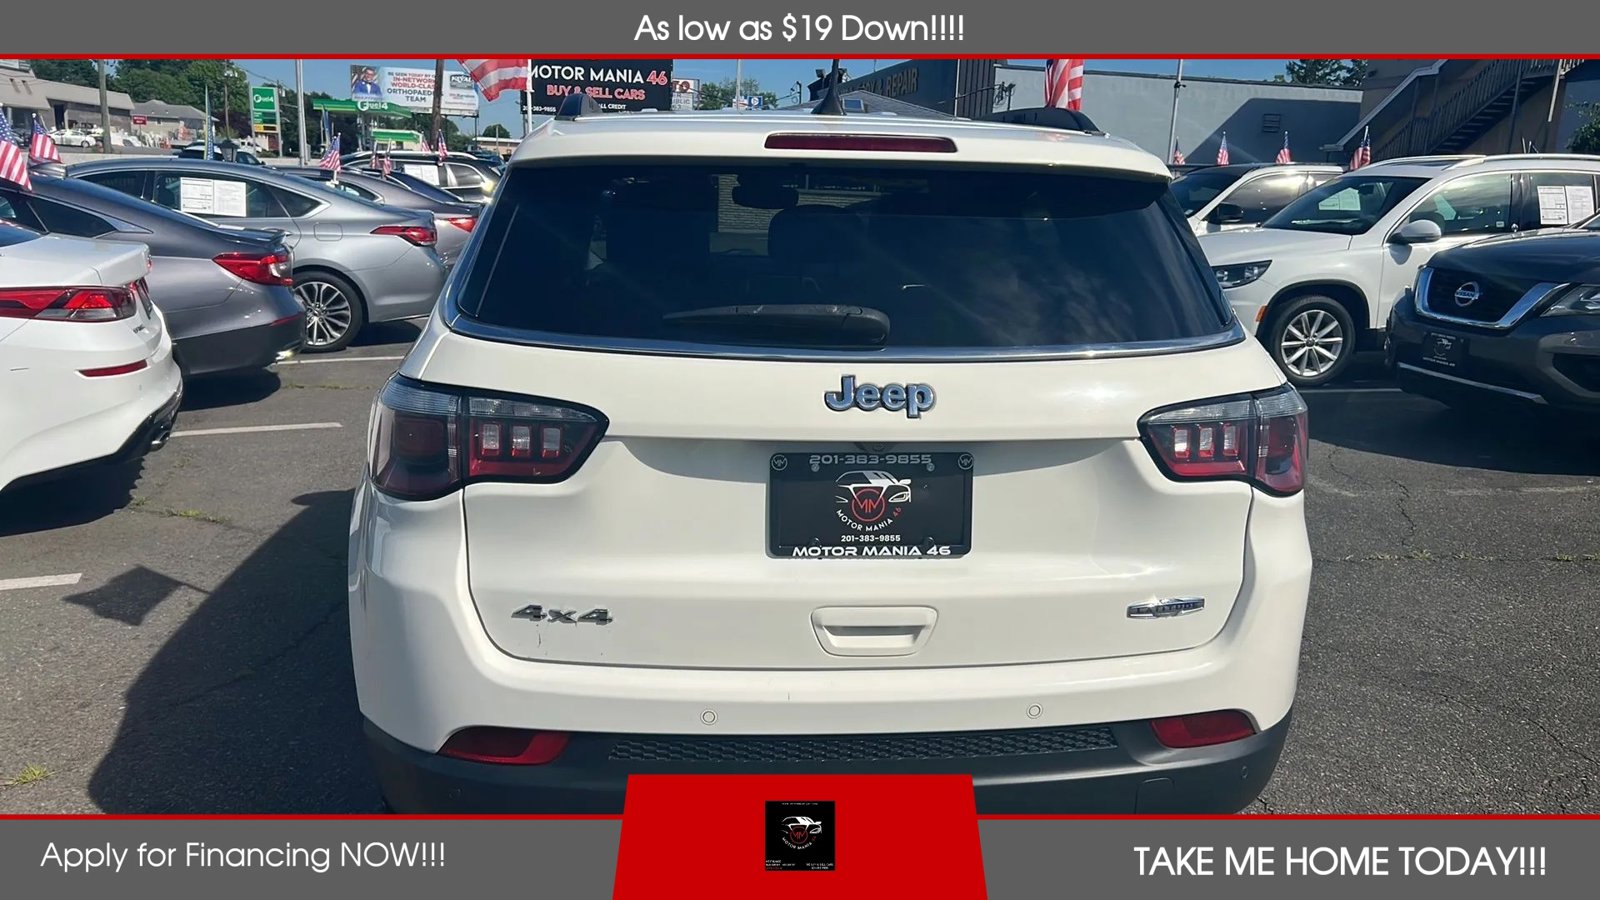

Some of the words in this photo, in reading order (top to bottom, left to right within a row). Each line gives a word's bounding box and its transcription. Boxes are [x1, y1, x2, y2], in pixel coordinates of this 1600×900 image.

[589, 68, 645, 84] MANIA
[645, 70, 669, 86] 46
[885, 67, 919, 98] REPAIR
[391, 82, 436, 90] WORLD-CLAS
[386, 88, 433, 97] ORTHOPAED
[546, 84, 571, 97] BUY
[584, 86, 614, 99] SELL
[614, 88, 646, 101] CARS
[405, 95, 427, 103] TEAM
[823, 374, 937, 420] Jeep
[809, 454, 933, 466] 201-383-9855
[836, 509, 863, 532] MOTOR
[865, 517, 894, 532] MANIA
[840, 534, 901, 543] 201-383-9855
[792, 545, 858, 557] MOTOR
[861, 545, 923, 557] MANIA
[926, 545, 952, 557] 46
